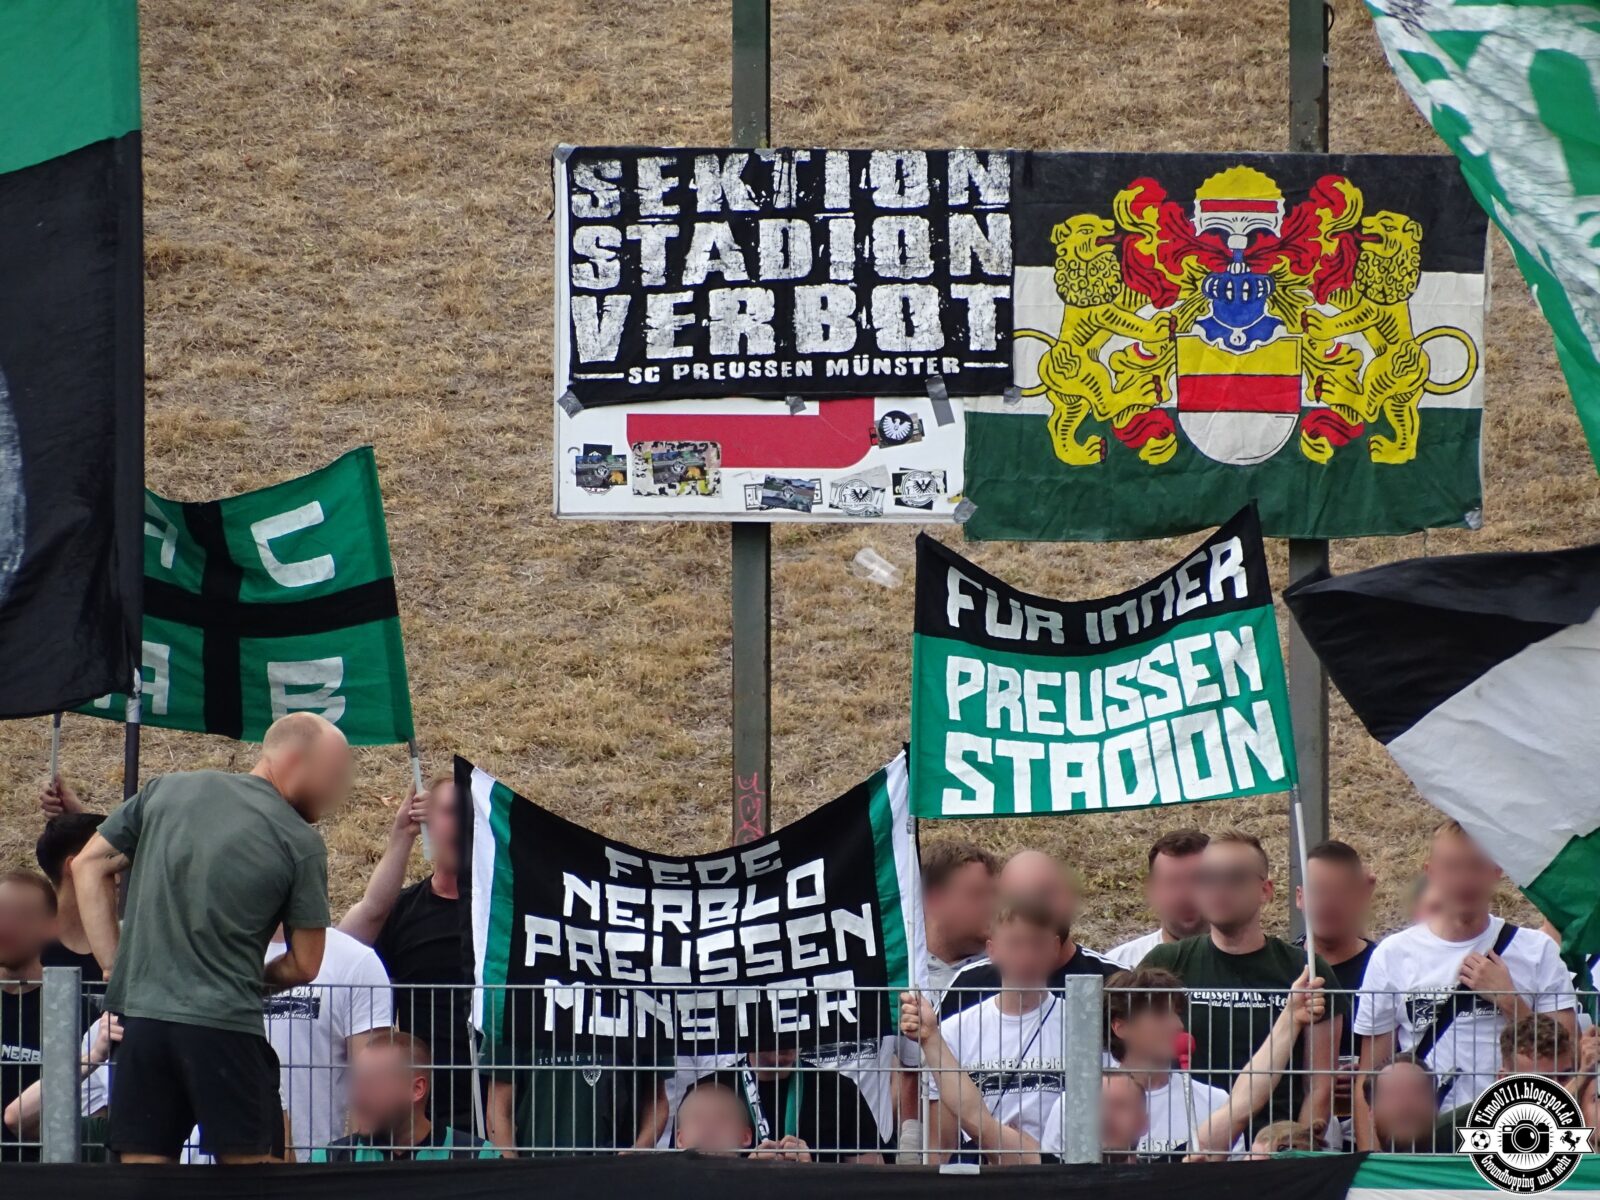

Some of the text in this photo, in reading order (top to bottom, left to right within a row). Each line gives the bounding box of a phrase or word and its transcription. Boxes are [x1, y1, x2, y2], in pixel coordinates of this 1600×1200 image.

[571, 149, 1010, 218] SEKTION
[571, 212, 1012, 289] STADION
[571, 283, 1010, 363] VERBOT
[628, 355, 960, 384] SC PREUSSEN MÜNSTER
[946, 536, 1248, 645] FÜR IMMER
[946, 625, 1264, 736] PREUSSEN
[941, 700, 1285, 816] STADION
[562, 858, 826, 934] NERBLO
[605, 840, 782, 885] FEDE
[524, 903, 876, 983] PREUSSEN
[544, 970, 858, 1040] MÜNSTER
[1, 1044, 41, 1062] NERB
